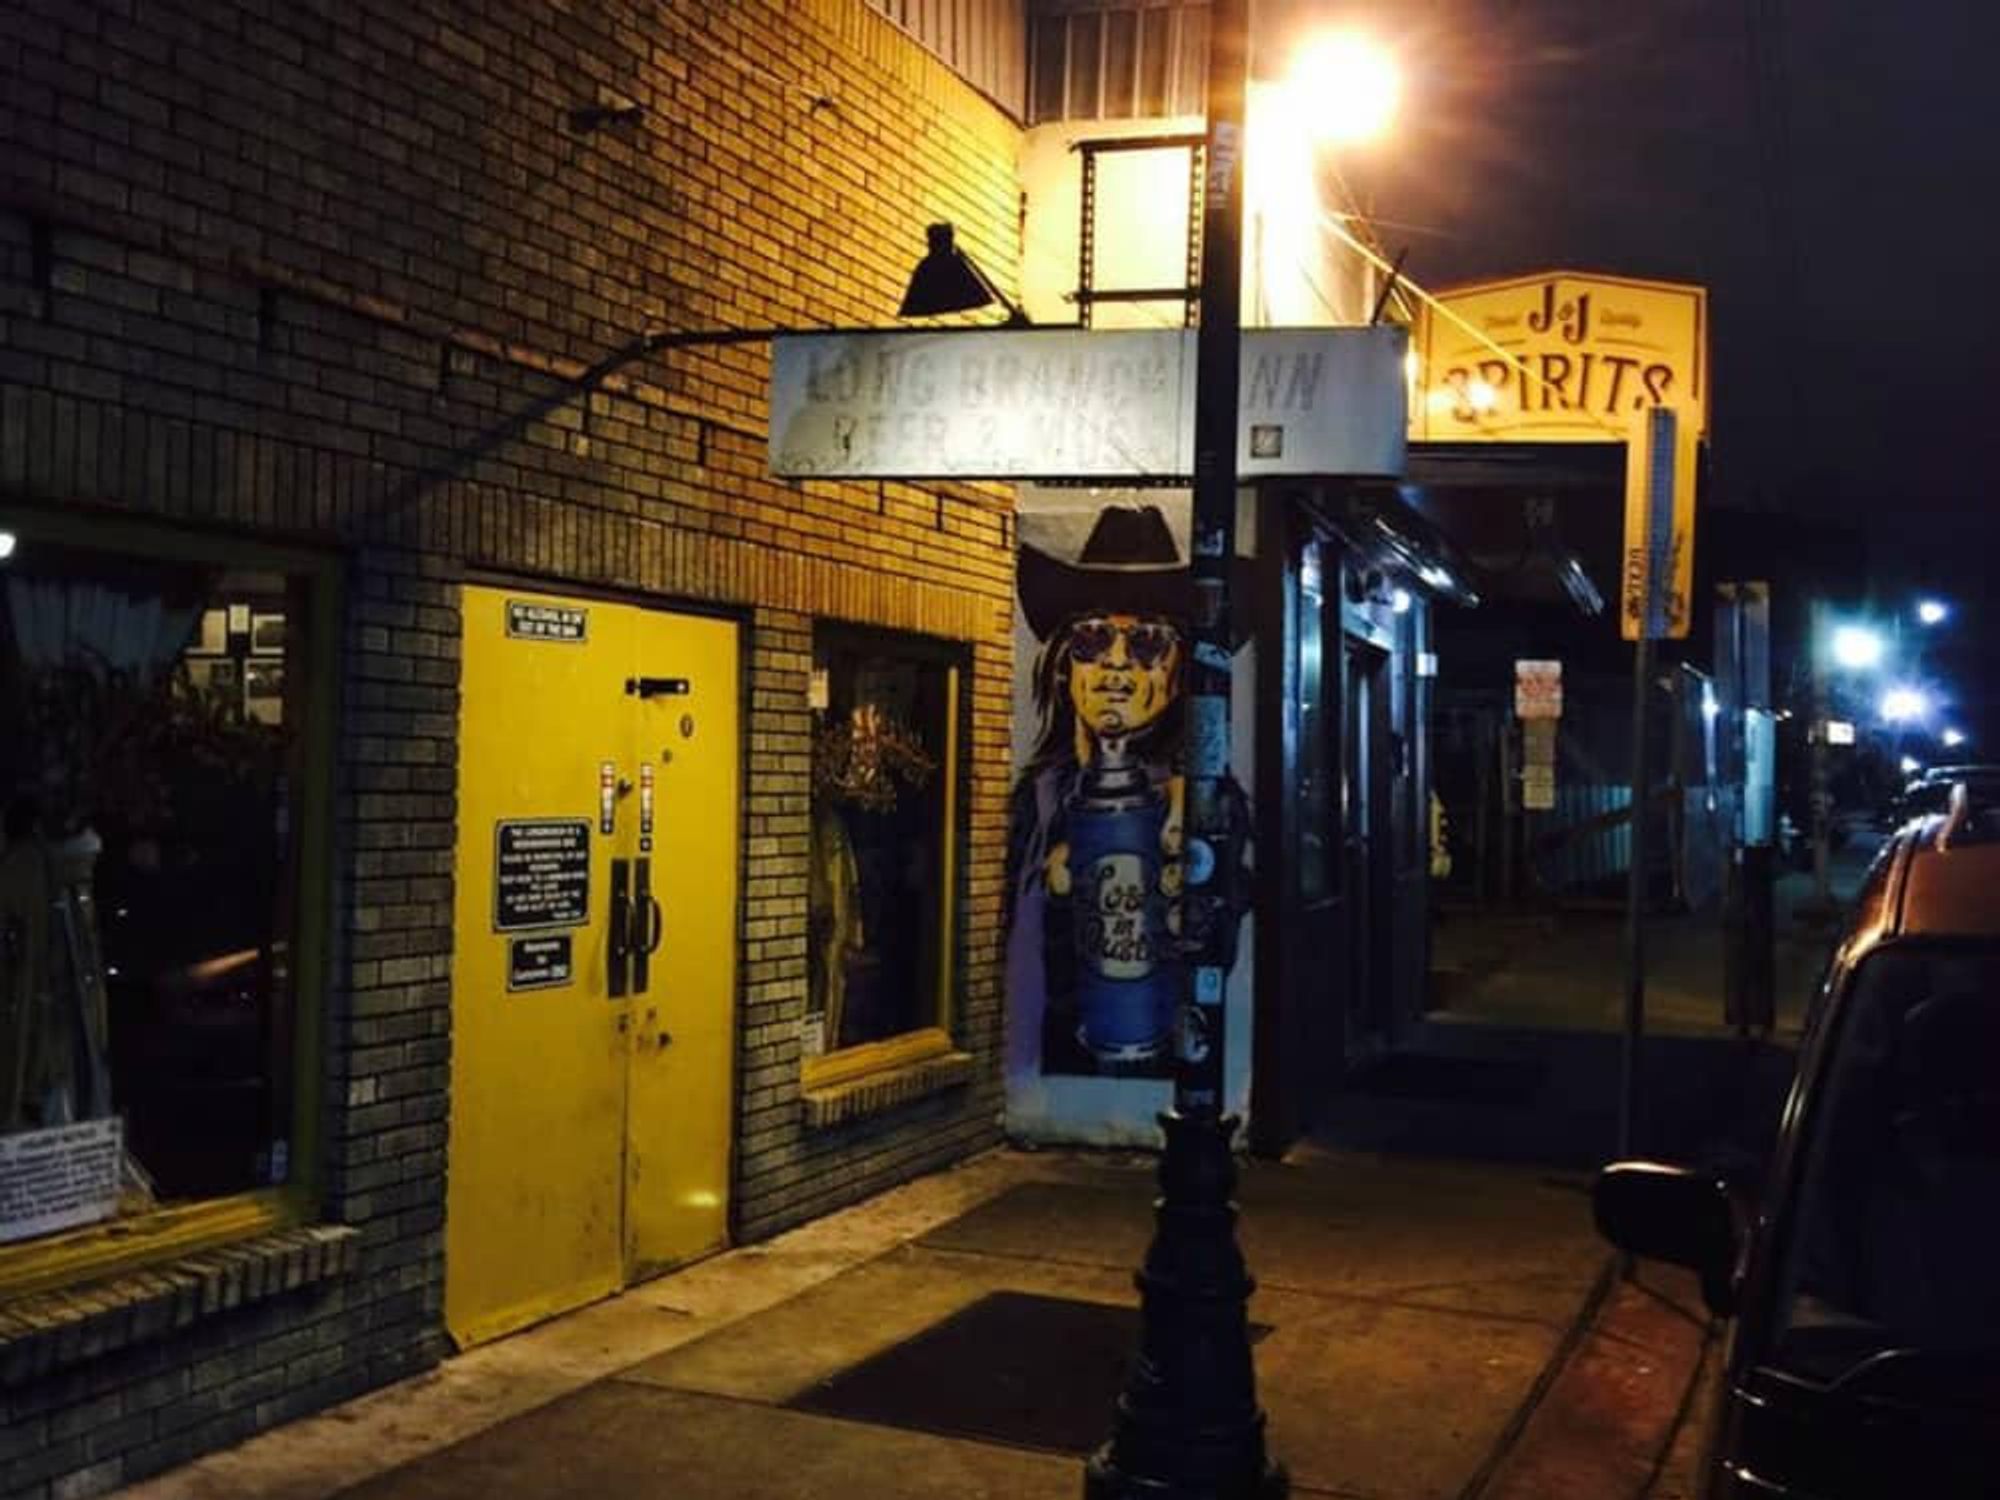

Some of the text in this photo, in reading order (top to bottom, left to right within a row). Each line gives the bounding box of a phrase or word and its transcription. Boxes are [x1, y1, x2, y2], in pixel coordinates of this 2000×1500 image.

[806, 350, 934, 406] LONG
[1246, 352, 1325, 411] NN
[1441, 351, 1674, 424] SPIRITS
